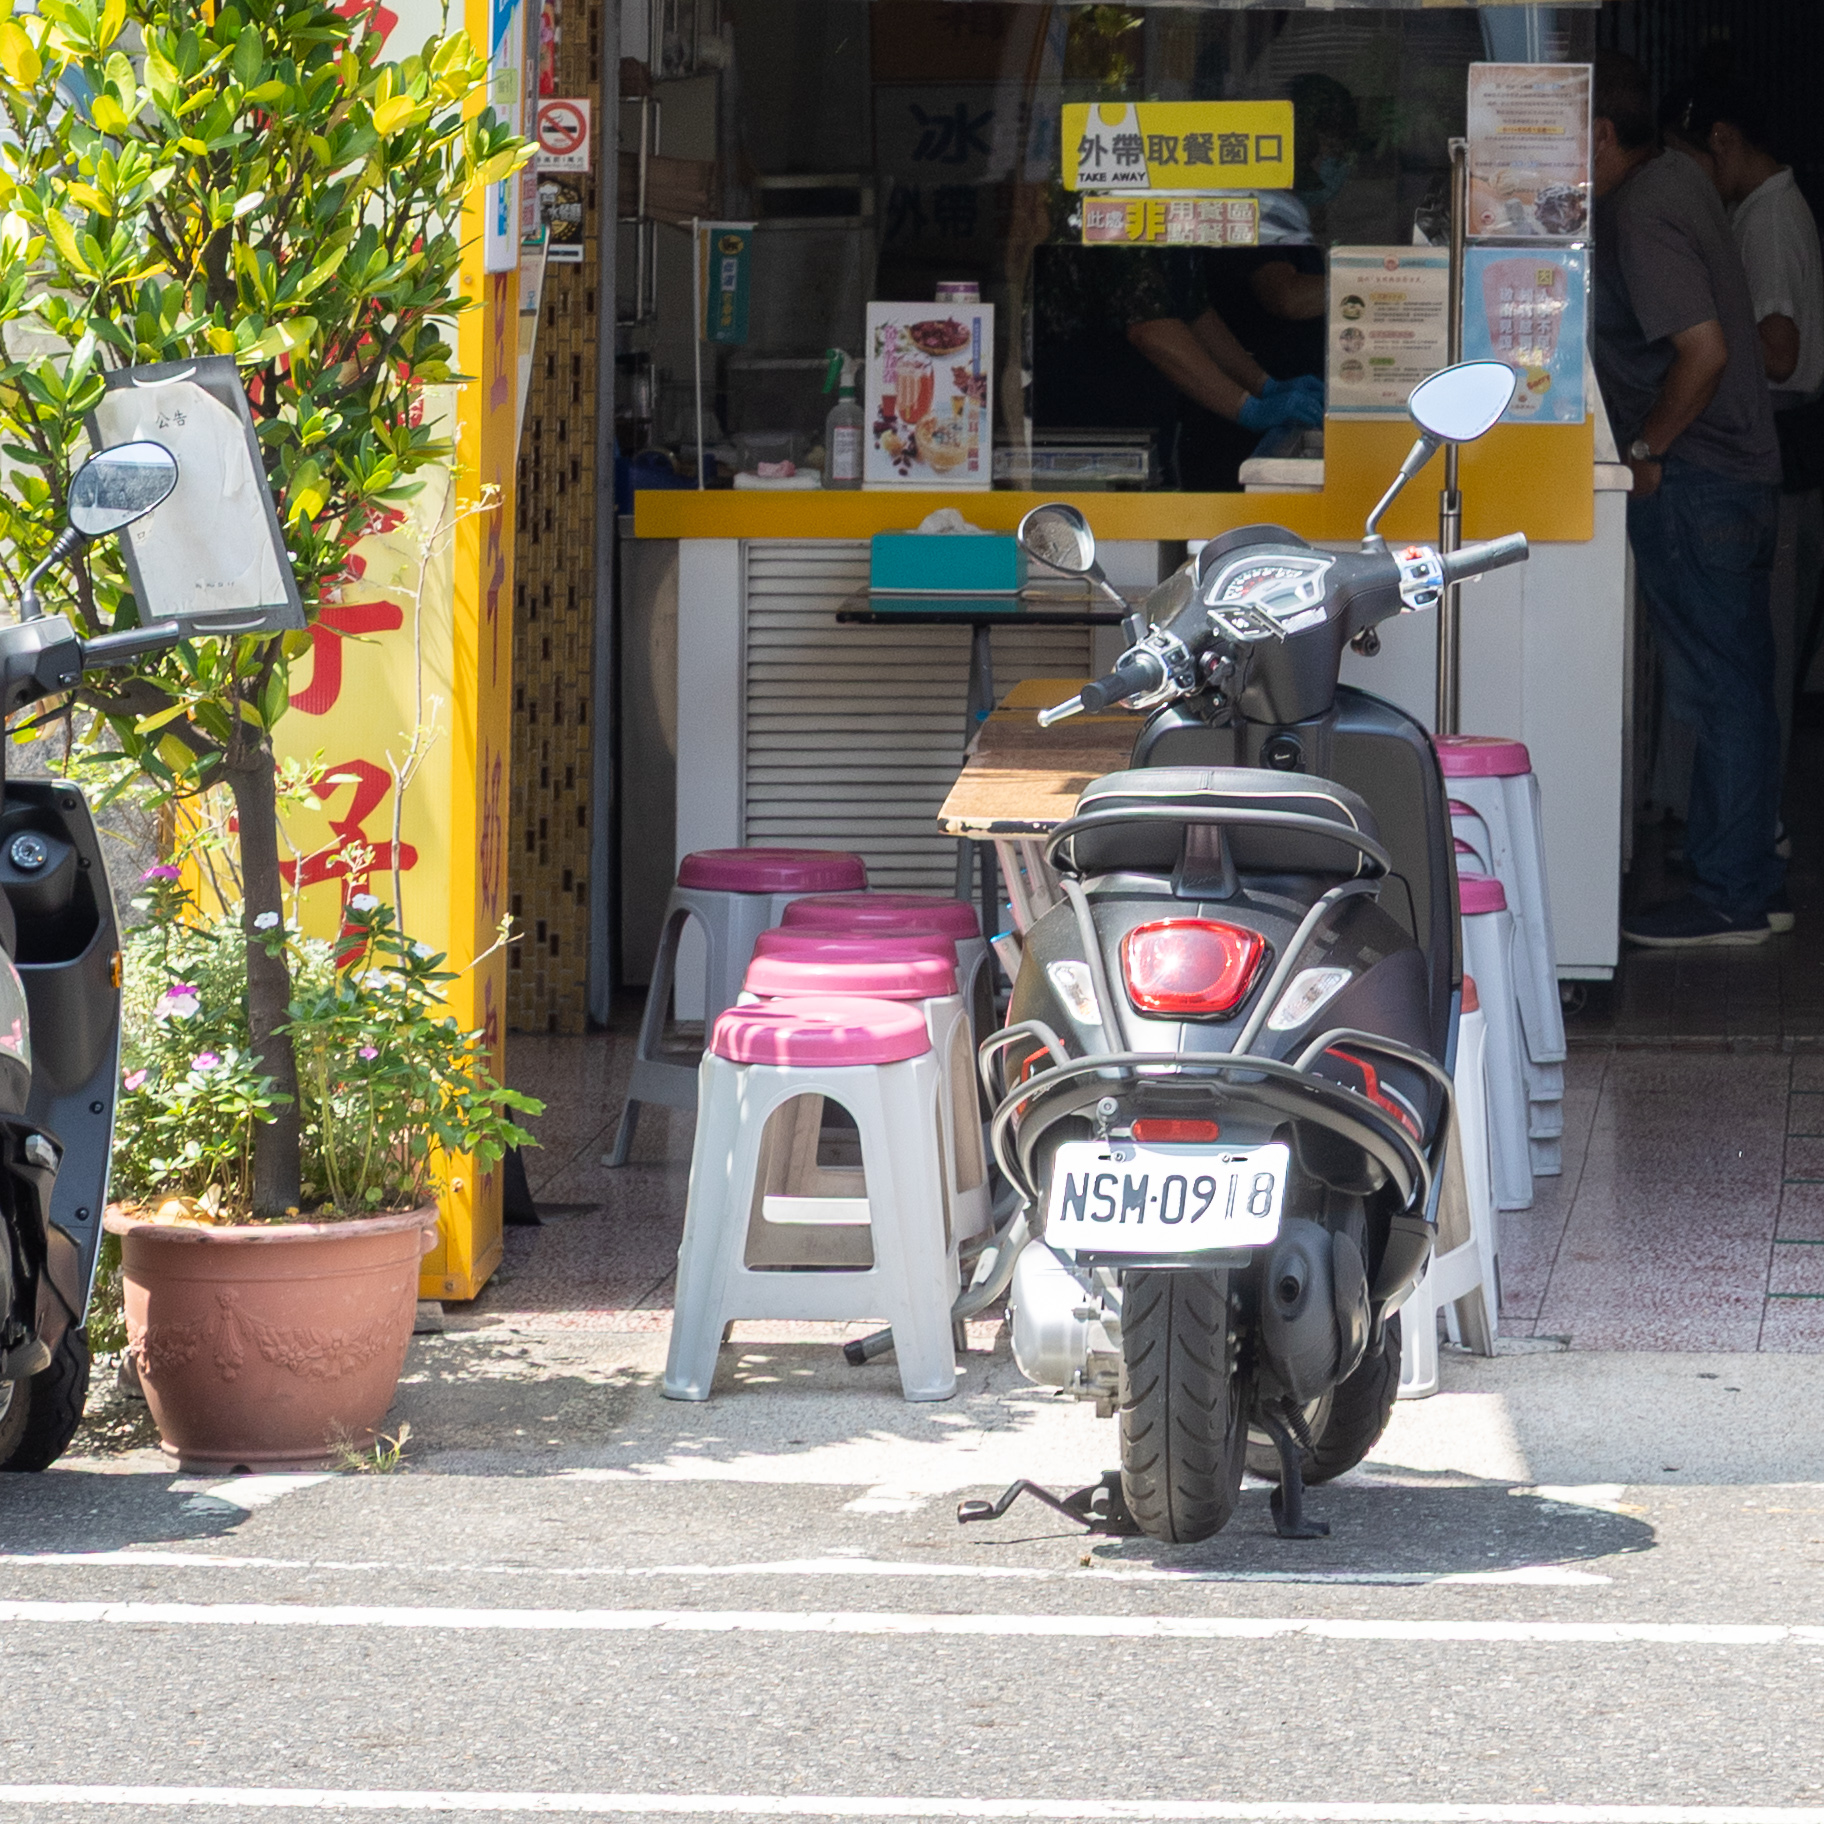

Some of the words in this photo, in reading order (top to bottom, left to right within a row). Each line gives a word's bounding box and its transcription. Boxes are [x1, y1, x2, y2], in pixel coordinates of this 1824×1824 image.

[1078, 133, 1283, 166] 外帶取餐窗口
[1078, 172, 1107, 183] TAKE
[1112, 171, 1147, 182] AWAY
[155, 409, 187, 430] 公告
